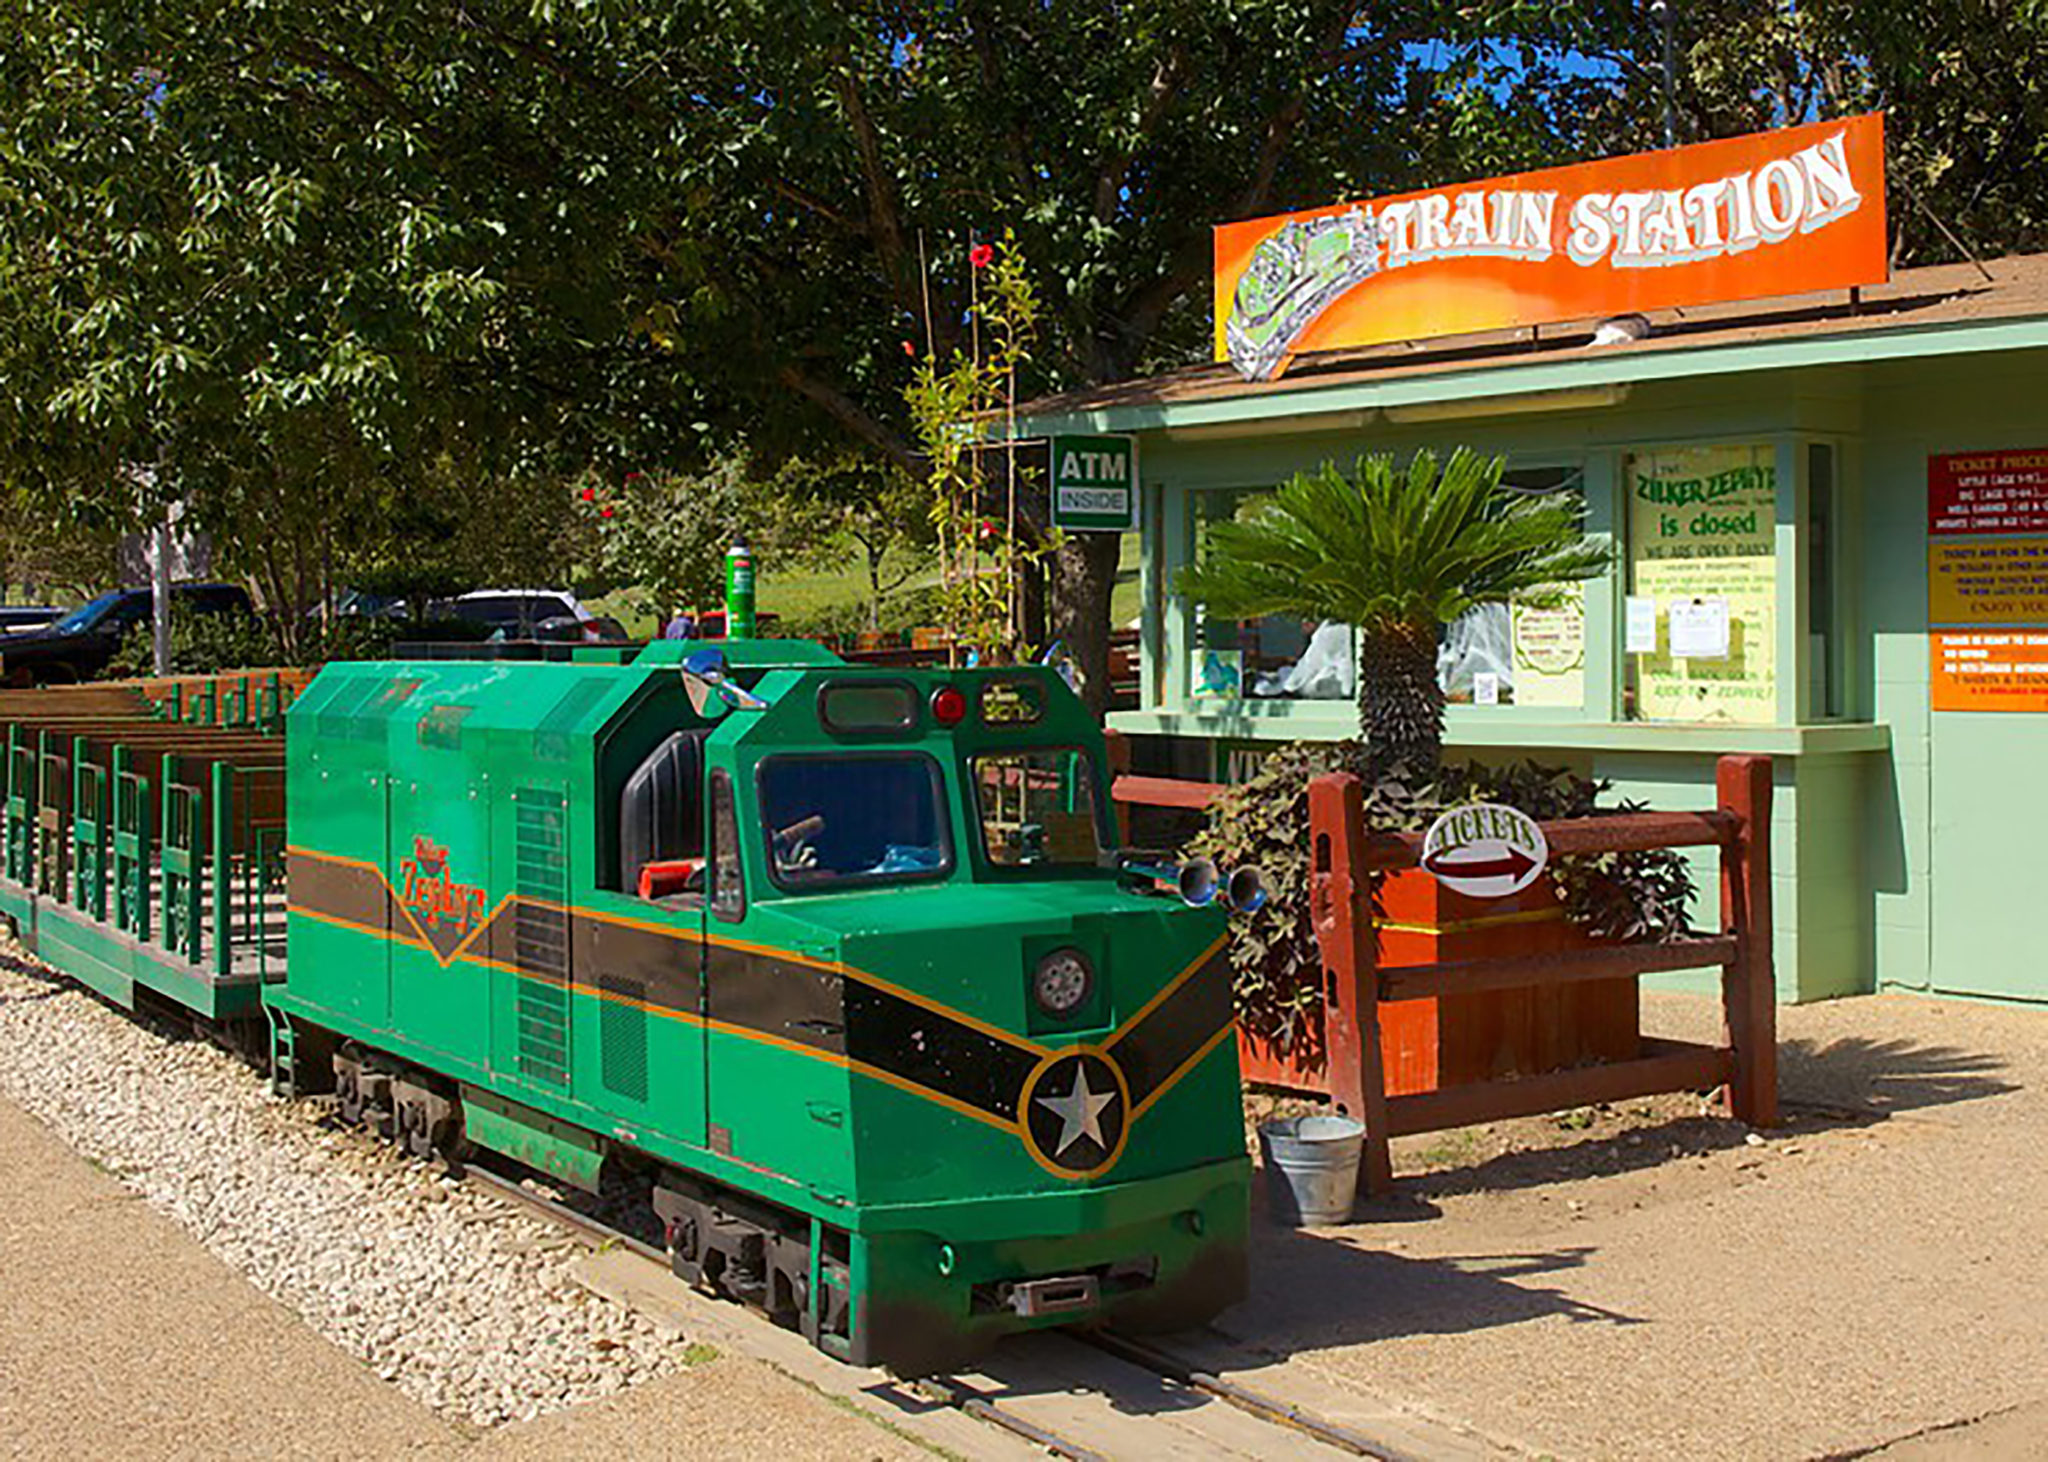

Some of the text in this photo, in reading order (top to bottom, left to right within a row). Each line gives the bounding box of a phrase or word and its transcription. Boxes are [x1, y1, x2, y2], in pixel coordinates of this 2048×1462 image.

[1379, 130, 1862, 268] TRAIN STATION
[1060, 451, 1126, 481] ATM
[1948, 458, 1997, 473] TICKET
[1062, 491, 1124, 509] INSIDE
[1636, 472, 1706, 508] ZILKER
[1660, 510, 1757, 538] is closed
[1433, 808, 1540, 851] TICKETS
